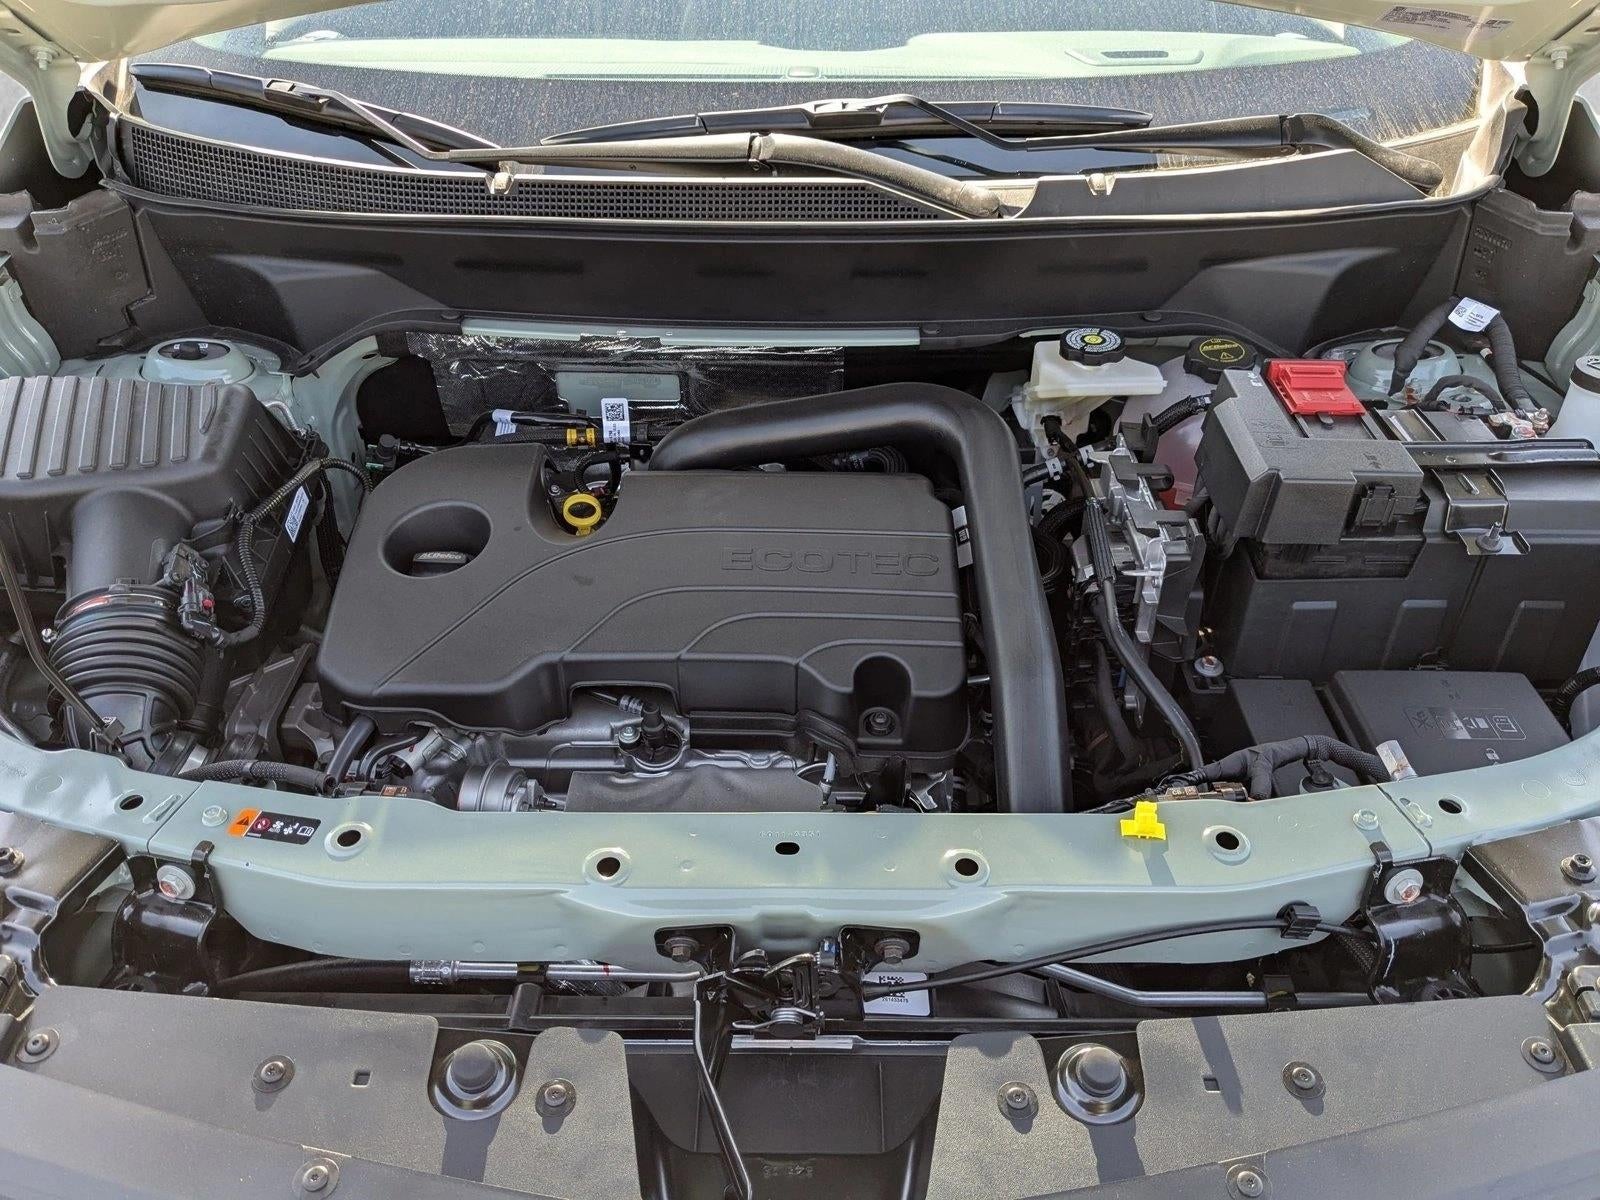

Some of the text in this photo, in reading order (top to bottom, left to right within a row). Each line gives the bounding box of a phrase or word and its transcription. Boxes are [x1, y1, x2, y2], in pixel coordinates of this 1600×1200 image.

[1202, 343, 1239, 351] ACDelco
[419, 552, 462, 560] ACDelco
[721, 547, 940, 577] ECOTEC
